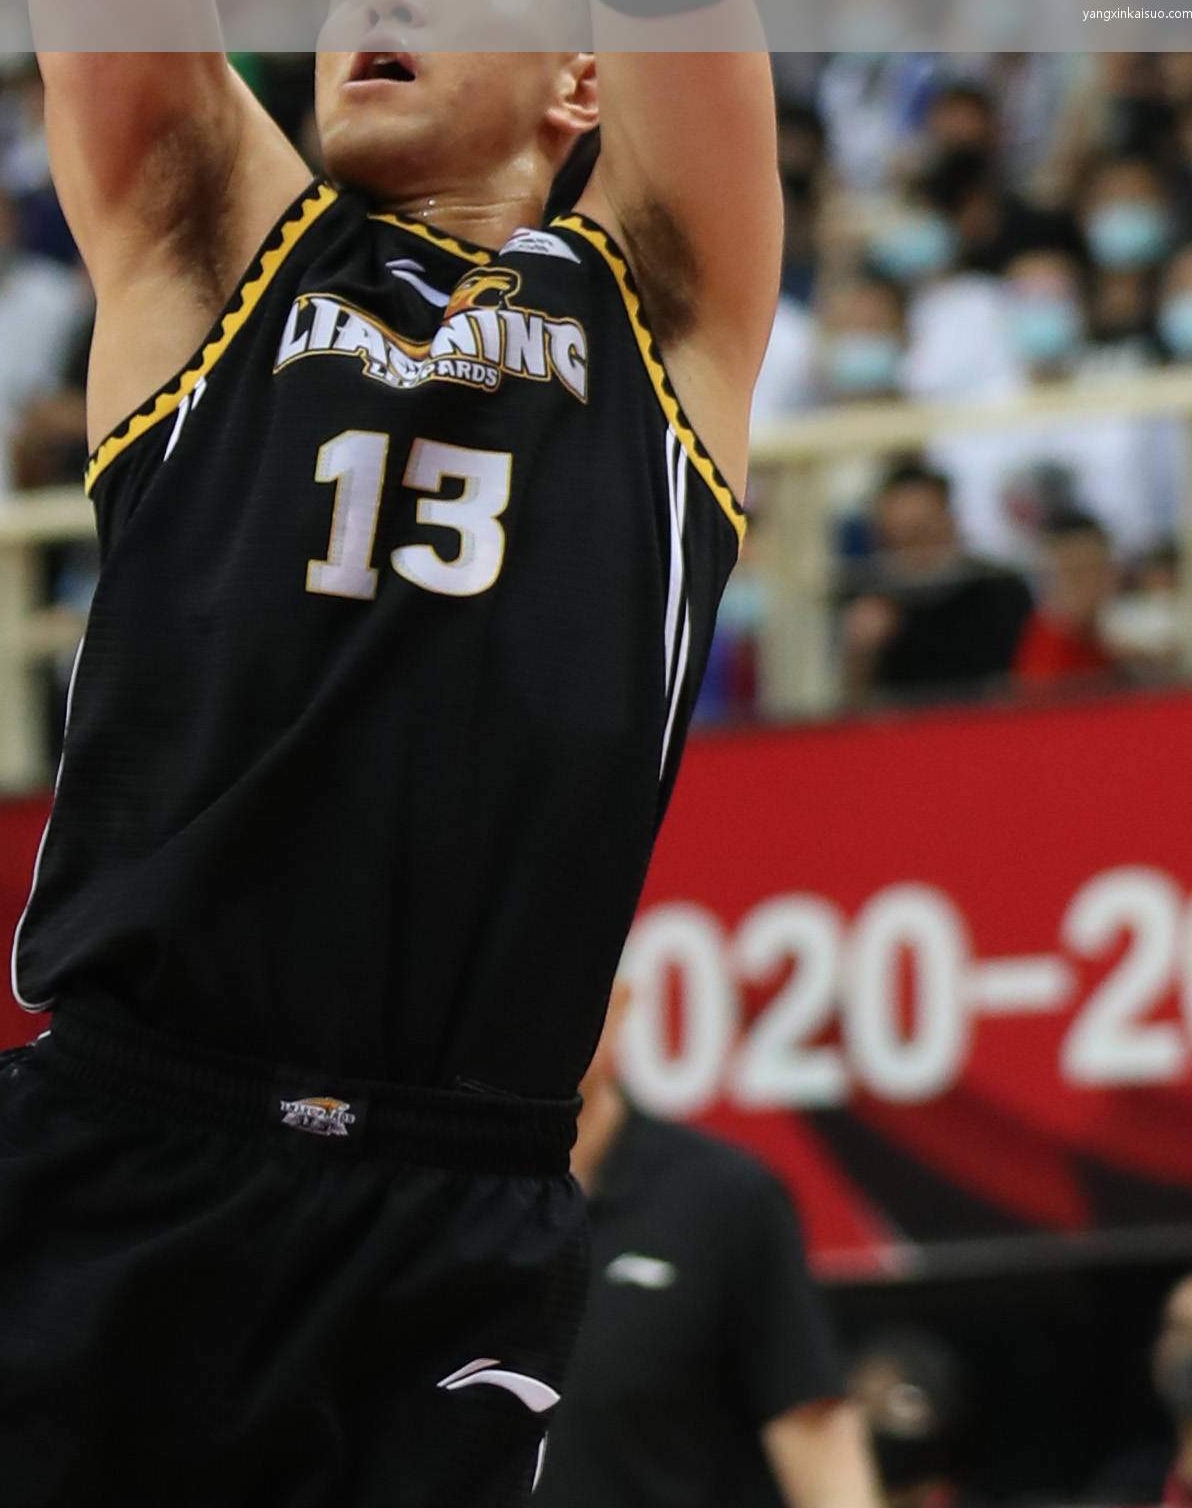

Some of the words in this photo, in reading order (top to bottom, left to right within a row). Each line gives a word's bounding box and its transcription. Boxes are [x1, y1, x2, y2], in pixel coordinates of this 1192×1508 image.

[273, 293, 589, 403] LIANING
[365, 356, 501, 390] LPARDS
[306, 429, 513, 600] 13
[611, 865, 1192, 1120] 020-2
